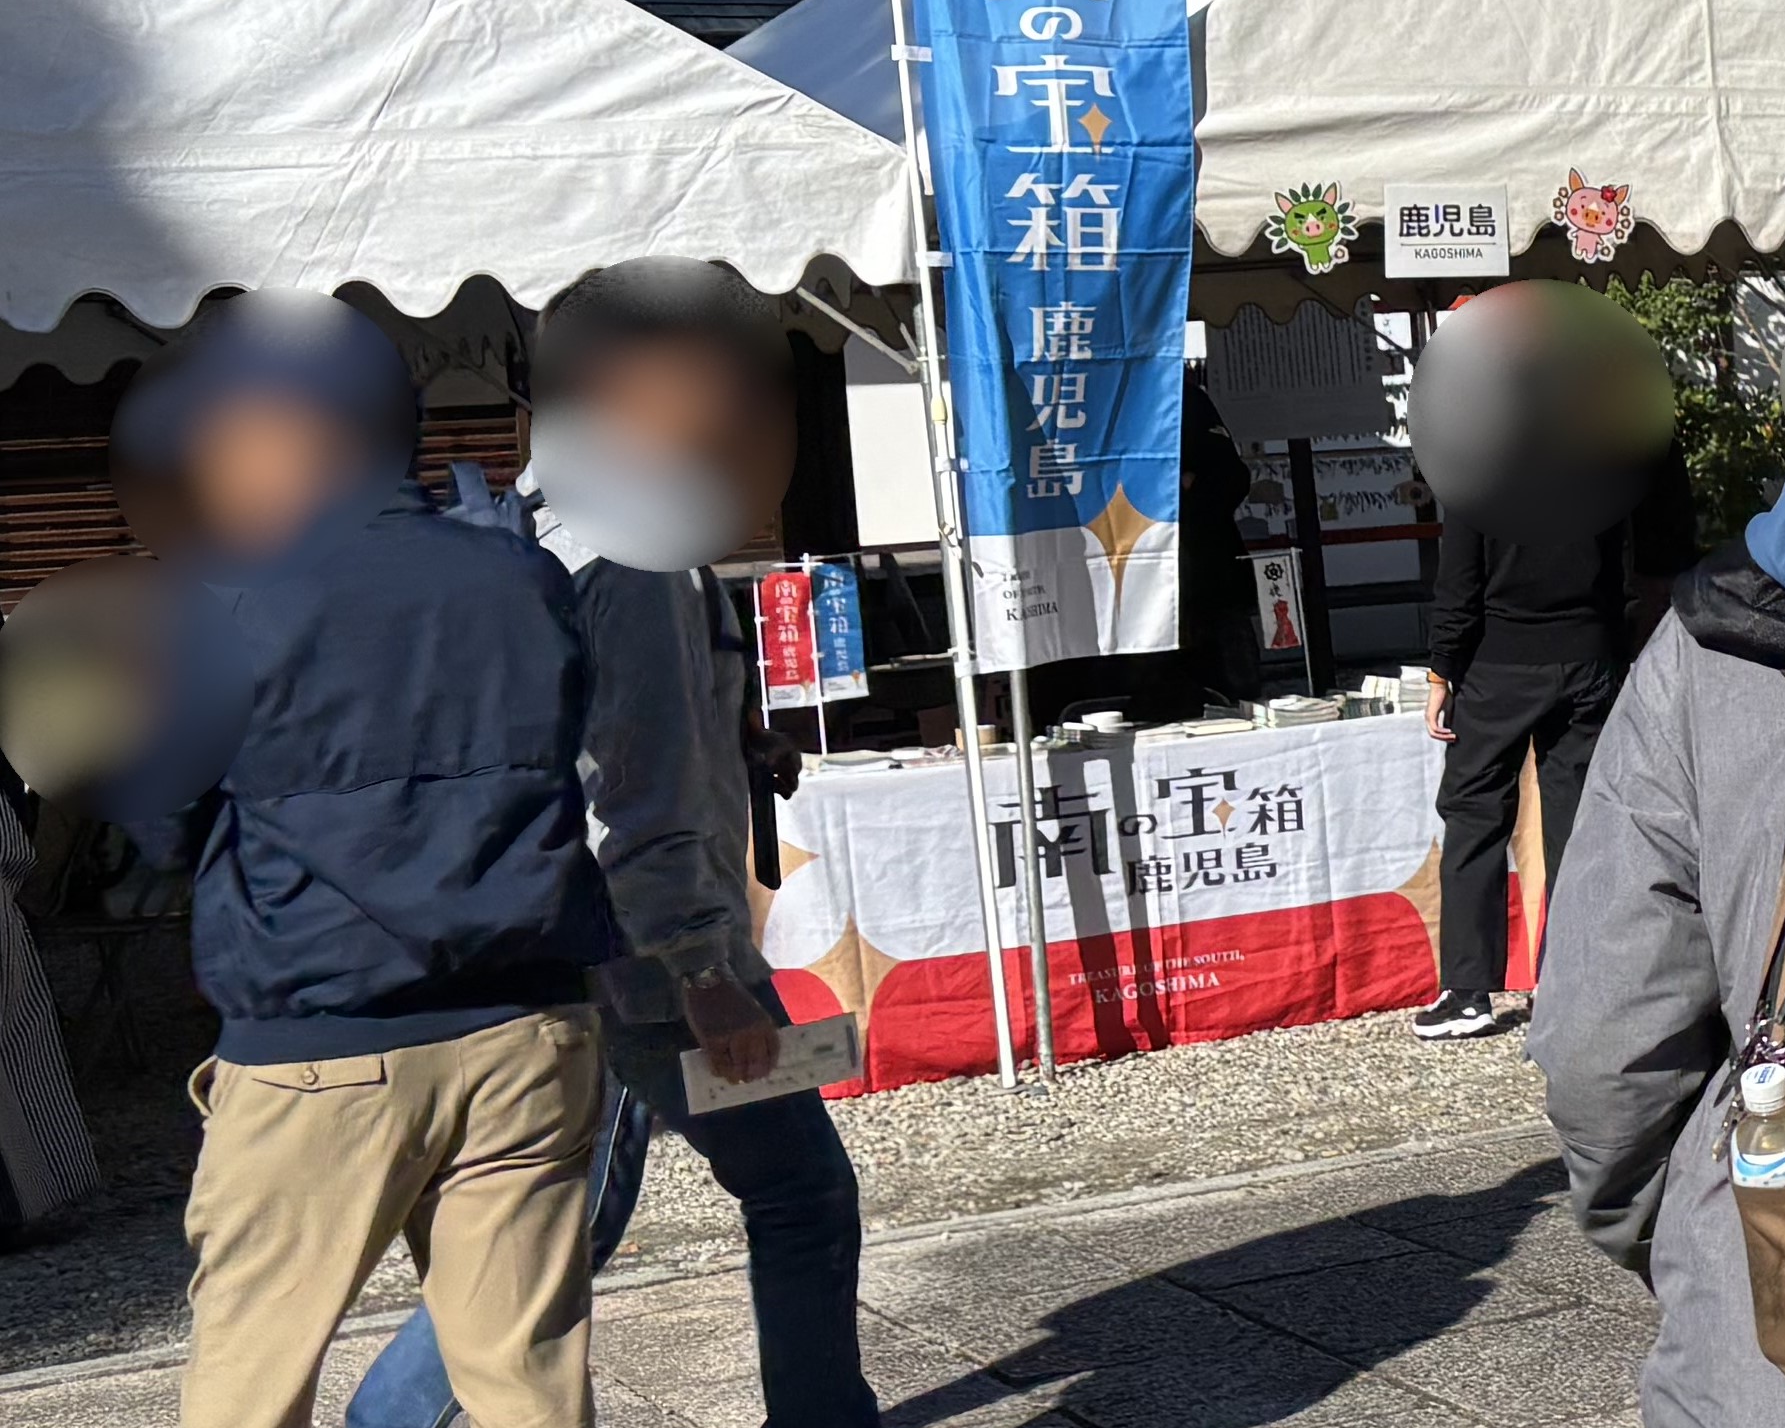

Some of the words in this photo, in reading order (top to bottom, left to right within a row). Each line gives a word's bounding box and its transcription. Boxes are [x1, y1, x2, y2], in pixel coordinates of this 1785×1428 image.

[1398, 203, 1496, 238] 鹿児島
[1414, 247, 1484, 260] KAGOSHIMA
[1026, 300, 1097, 500] 鹿児島
[989, 767, 1305, 889] 南の宝箱
[1126, 841, 1279, 897] 鹿児島
[1095, 971, 1221, 1004] KAGOSHIMA
